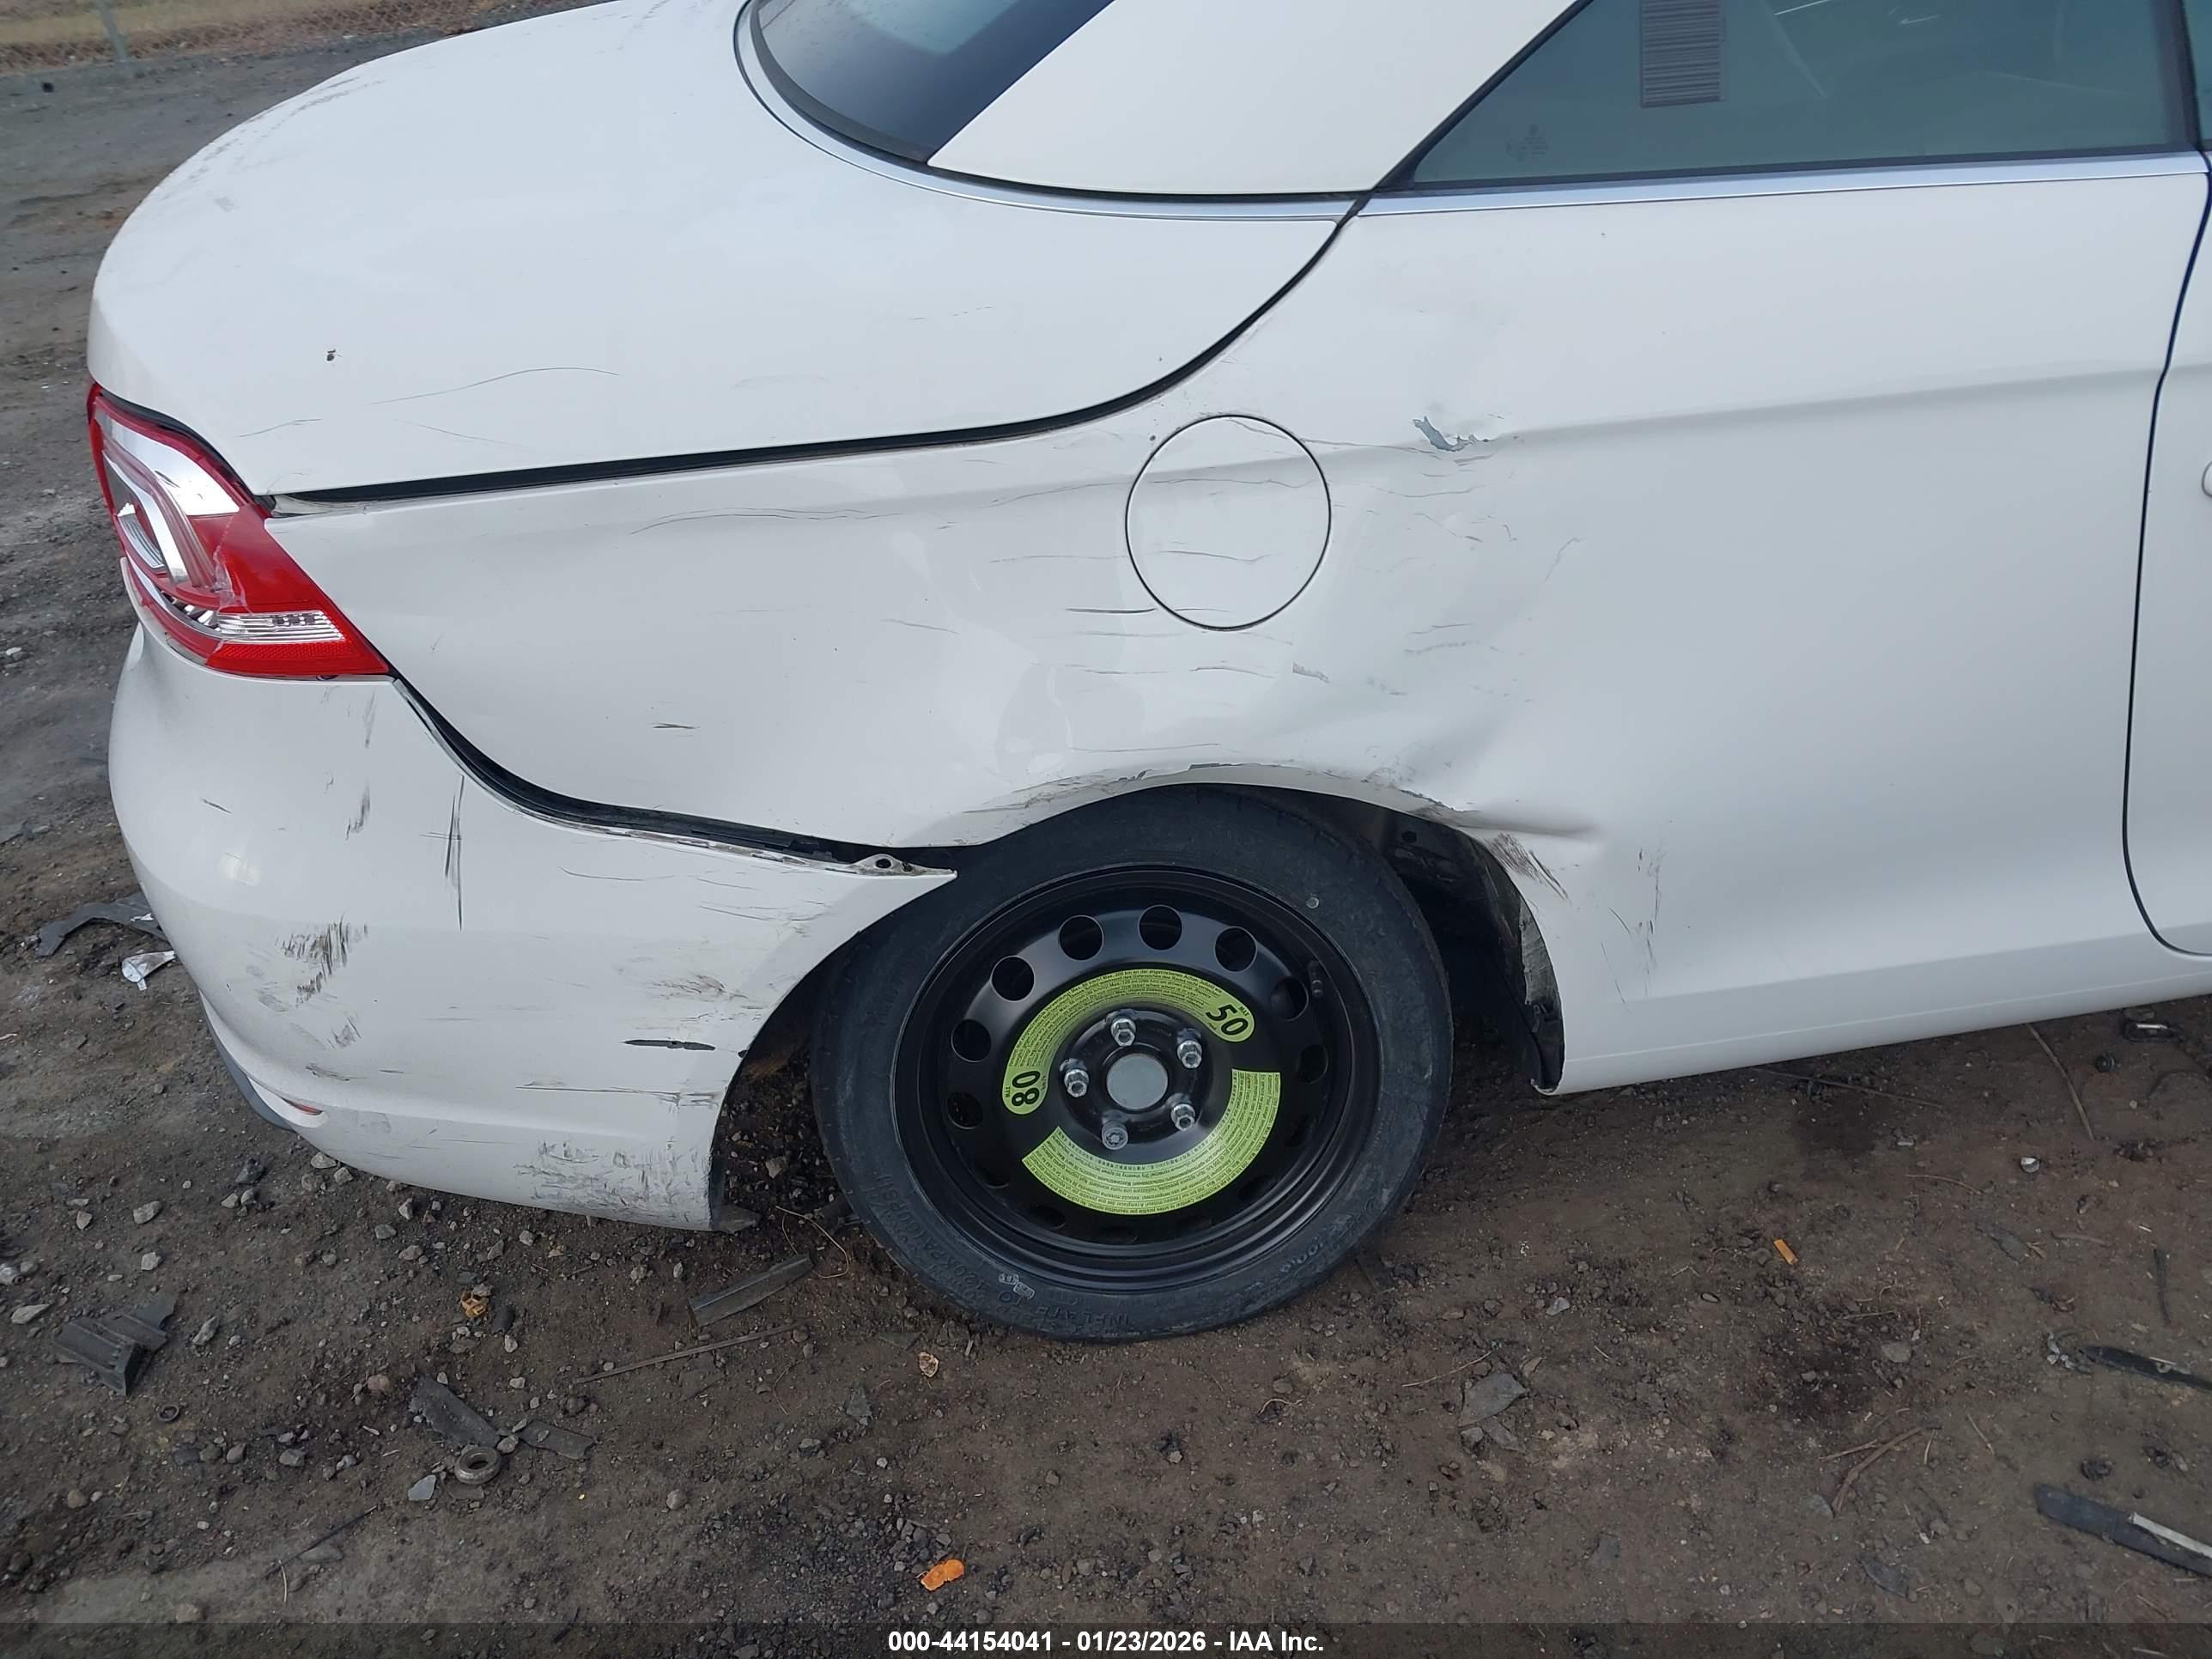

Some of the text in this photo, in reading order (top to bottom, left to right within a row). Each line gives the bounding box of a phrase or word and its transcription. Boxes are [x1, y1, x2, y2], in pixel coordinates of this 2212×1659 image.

[1205, 1003, 1249, 1036] 50
[1012, 1070, 1041, 1107] 80
[999, 1290, 1024, 1305] TO
[1035, 1304, 1130, 1327] INFLATE
